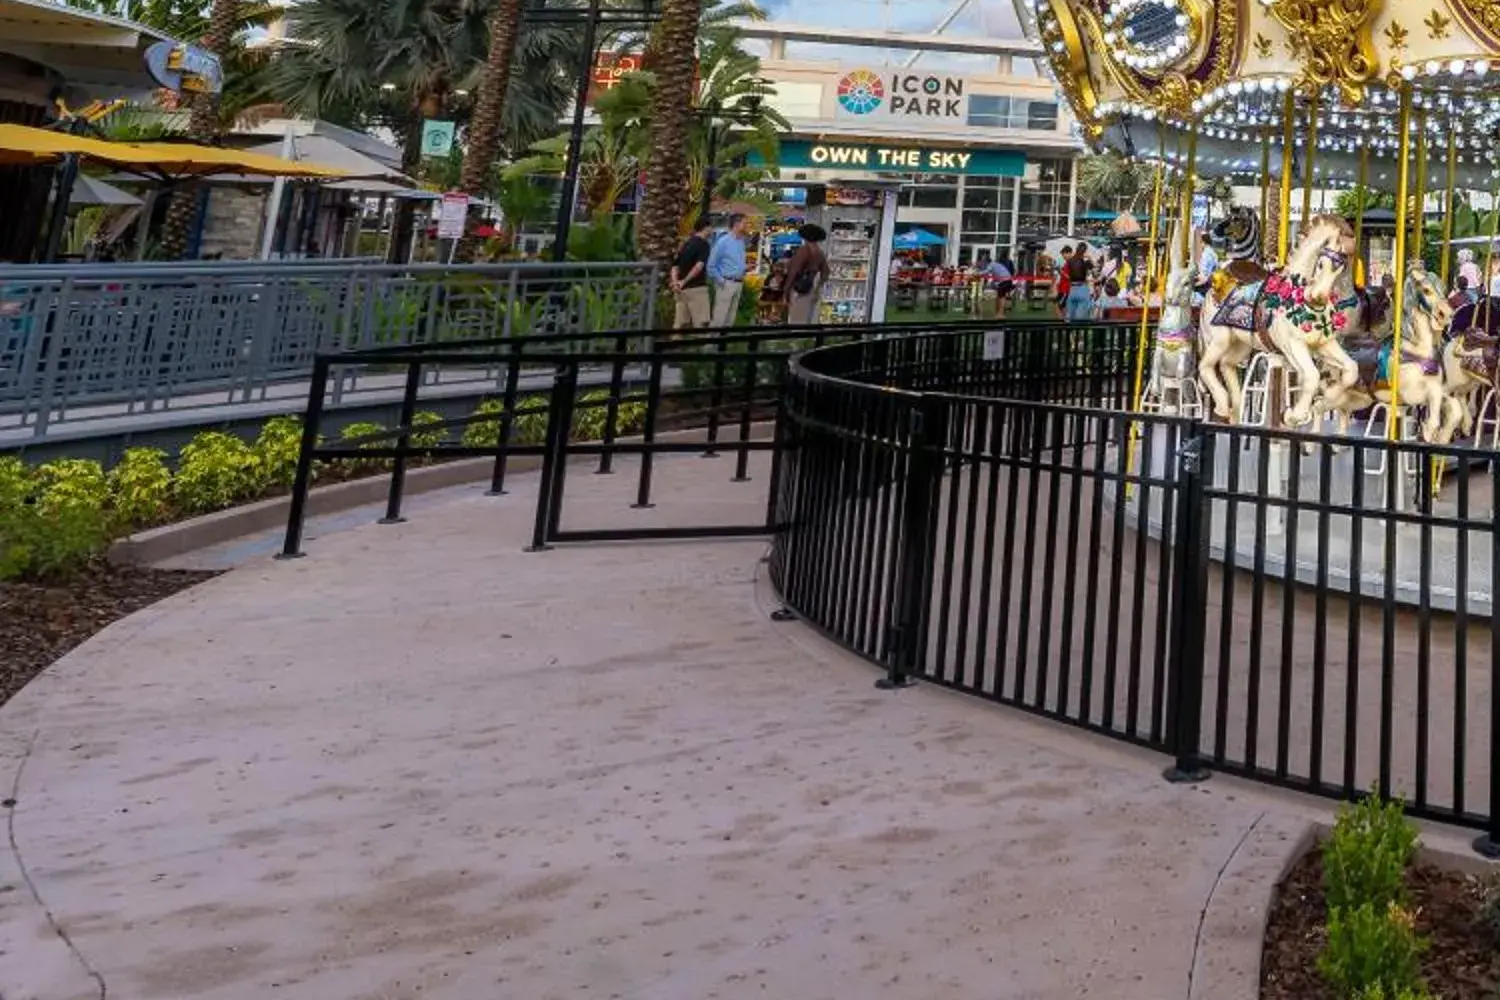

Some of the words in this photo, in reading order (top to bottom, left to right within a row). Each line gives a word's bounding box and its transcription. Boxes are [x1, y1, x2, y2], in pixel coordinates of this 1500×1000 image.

[891, 74, 963, 96] ICON
[889, 96, 961, 117] PARK
[811, 146, 868, 165] OWN
[877, 149, 921, 167] THE
[929, 151, 971, 169] SKY
